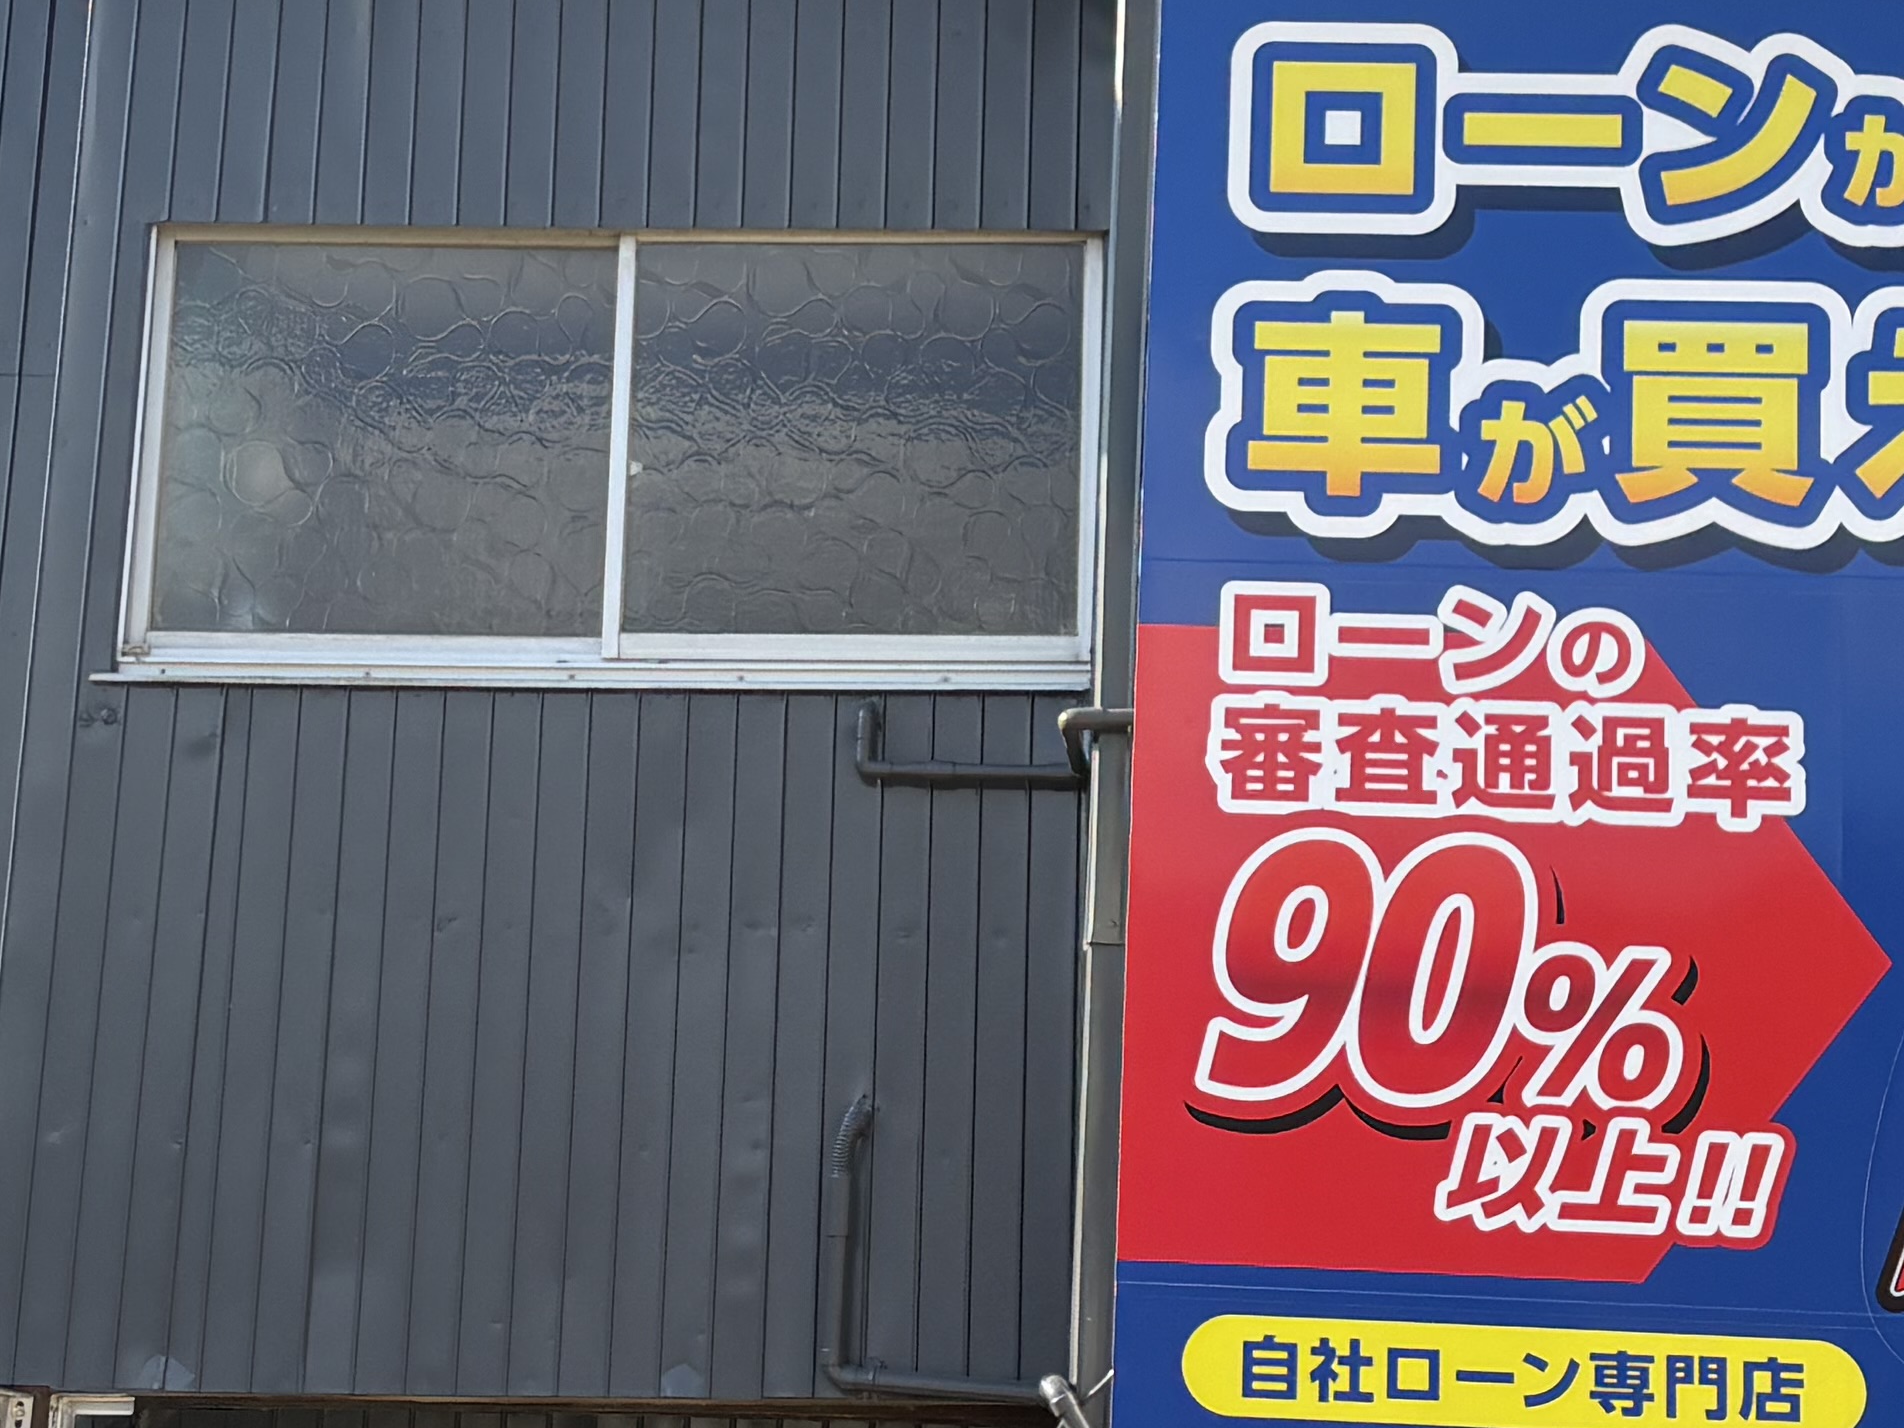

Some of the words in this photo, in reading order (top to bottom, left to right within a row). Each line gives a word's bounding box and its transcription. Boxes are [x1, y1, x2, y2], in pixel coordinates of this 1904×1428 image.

[1224, 587, 1641, 694] ローンの
[1212, 698, 1802, 826] 審査通過率
[1200, 830, 1684, 1106] 90%
[1241, 1337, 1805, 1424] 自社ローン専門店
